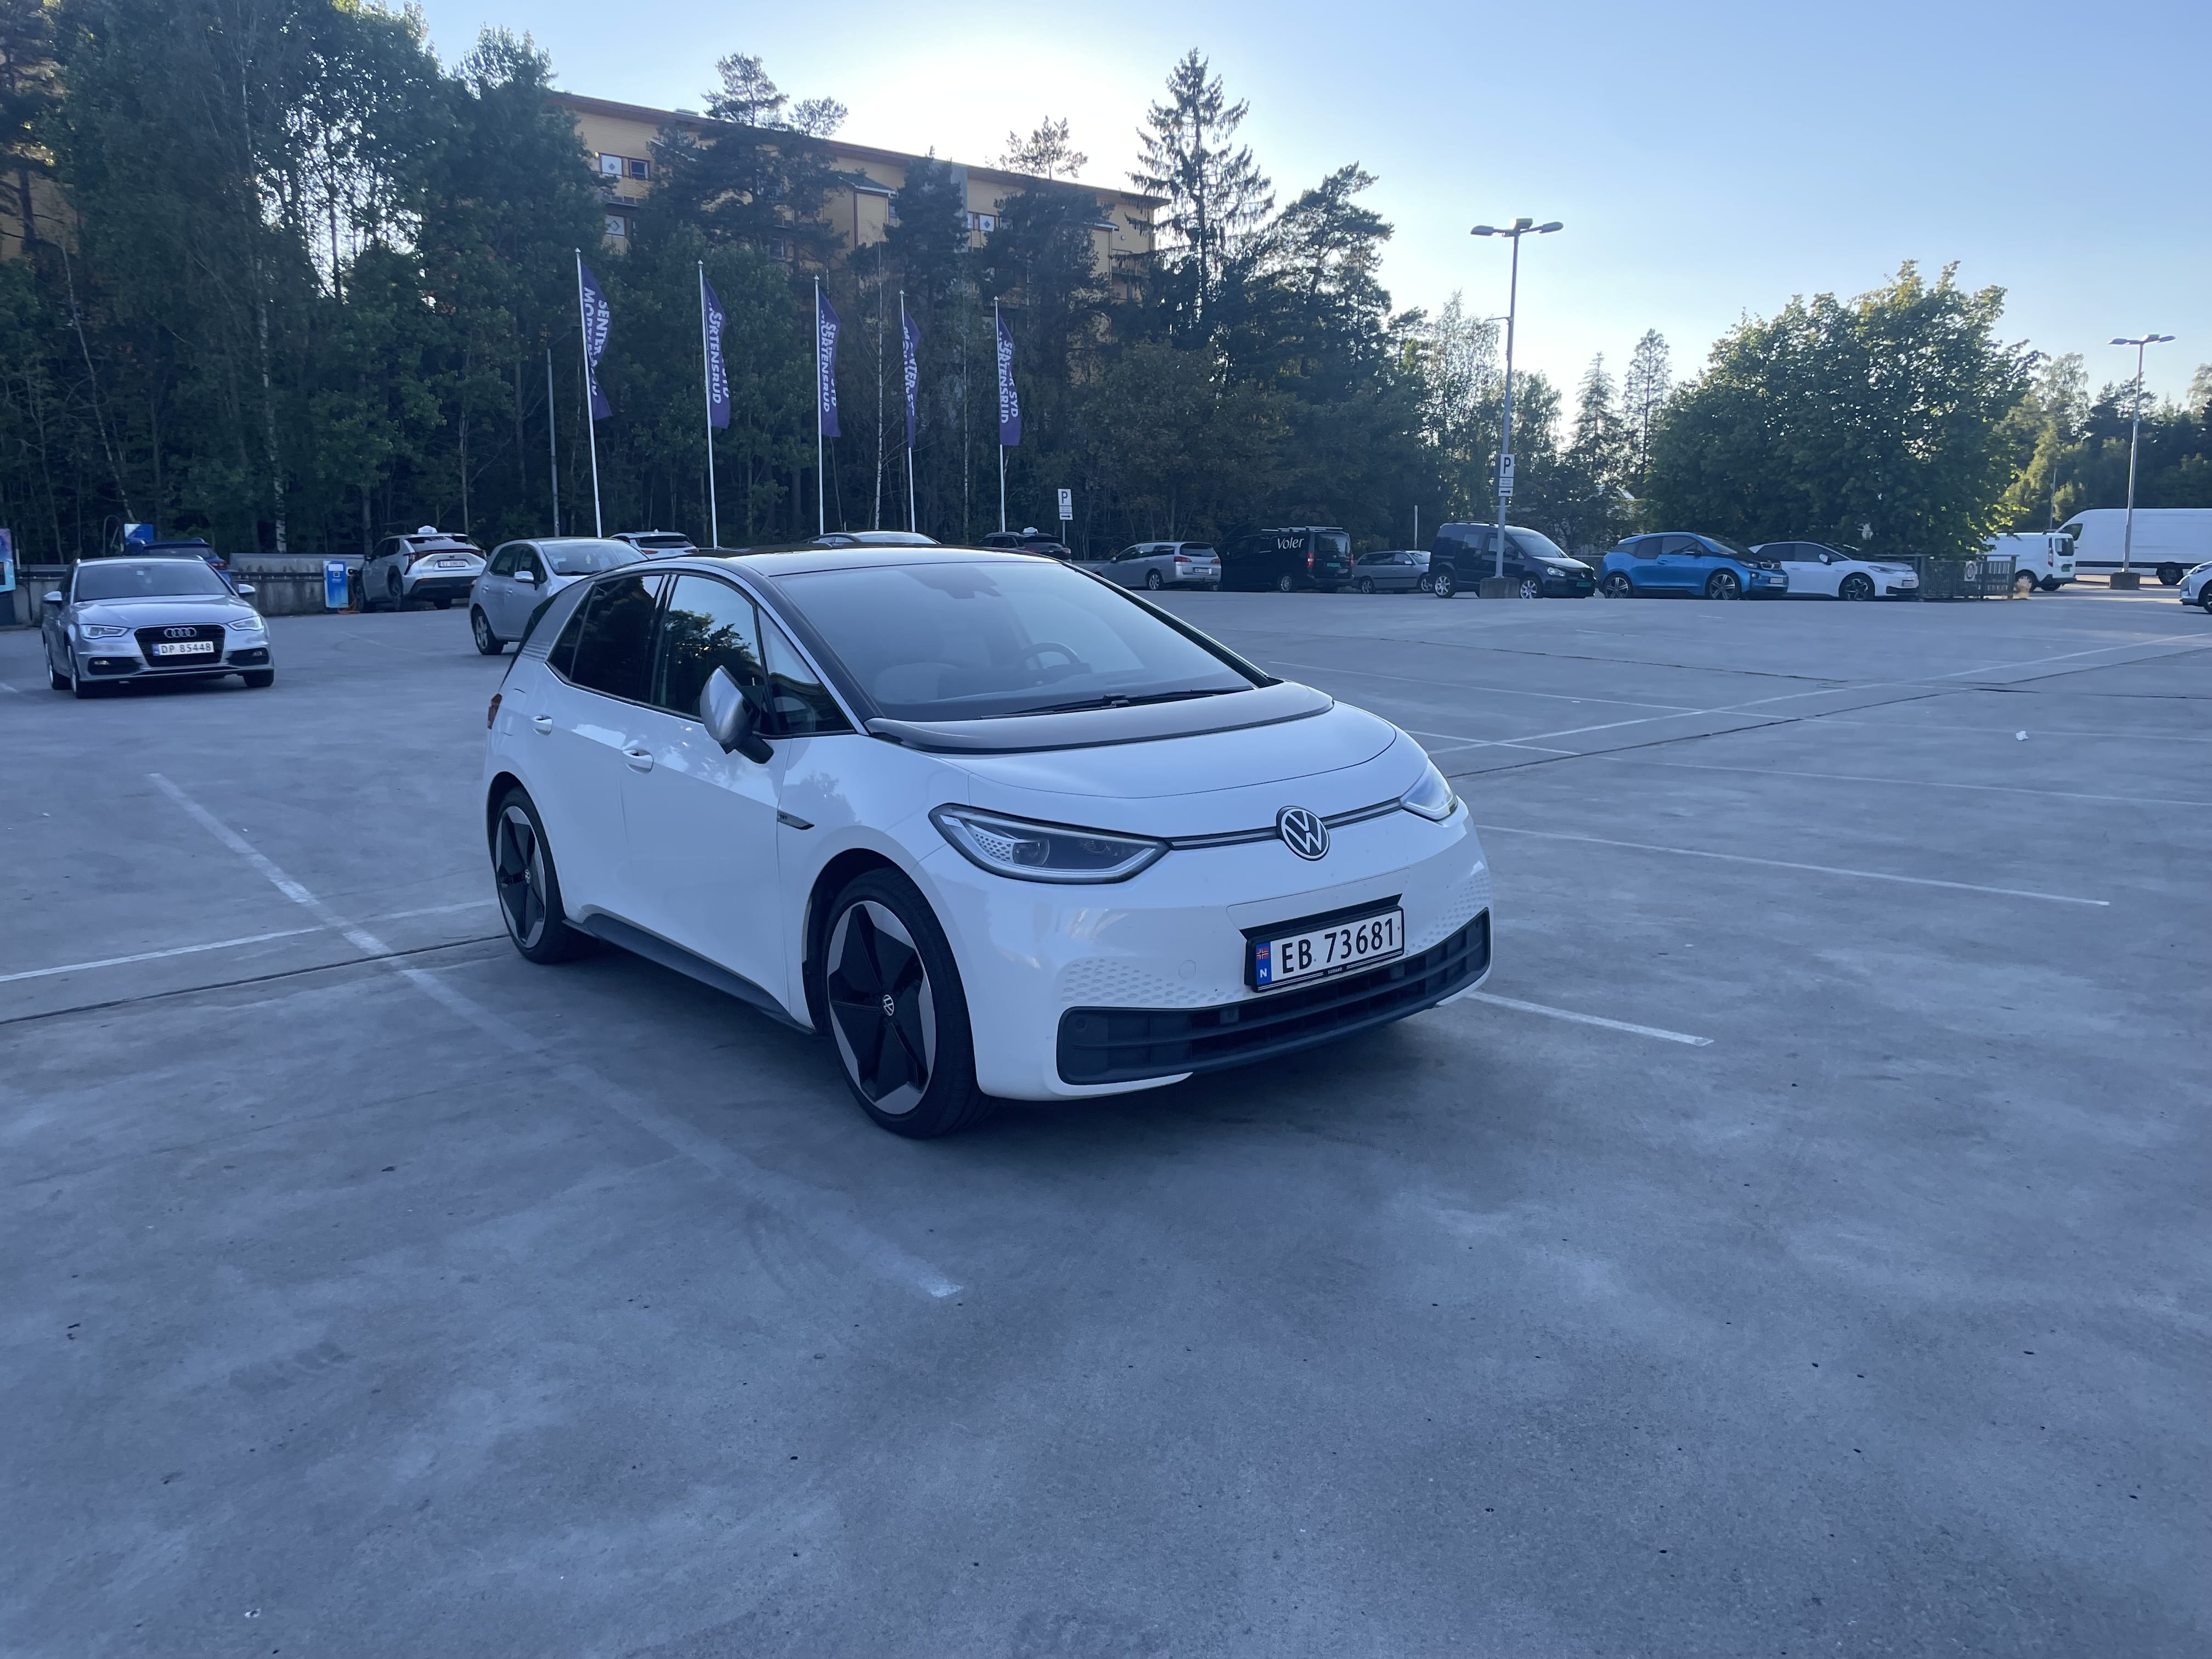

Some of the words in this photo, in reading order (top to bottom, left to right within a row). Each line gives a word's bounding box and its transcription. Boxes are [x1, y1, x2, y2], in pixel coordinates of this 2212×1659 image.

[594, 300, 610, 356] SENTER
[708, 301, 721, 404] ORTENSRUD
[821, 310, 830, 413] ORTENSRUD
[1009, 391, 1019, 417] SYD
[1503, 456, 1511, 474] P
[1061, 491, 1068, 504] P
[1277, 537, 1305, 549] Voler
[161, 645, 174, 653] DP
[179, 643, 211, 653] 85448
[1282, 809, 1327, 857] VW
[1282, 939, 1312, 974] EB
[1324, 918, 1393, 963] 73681
[1260, 968, 1267, 978] N
